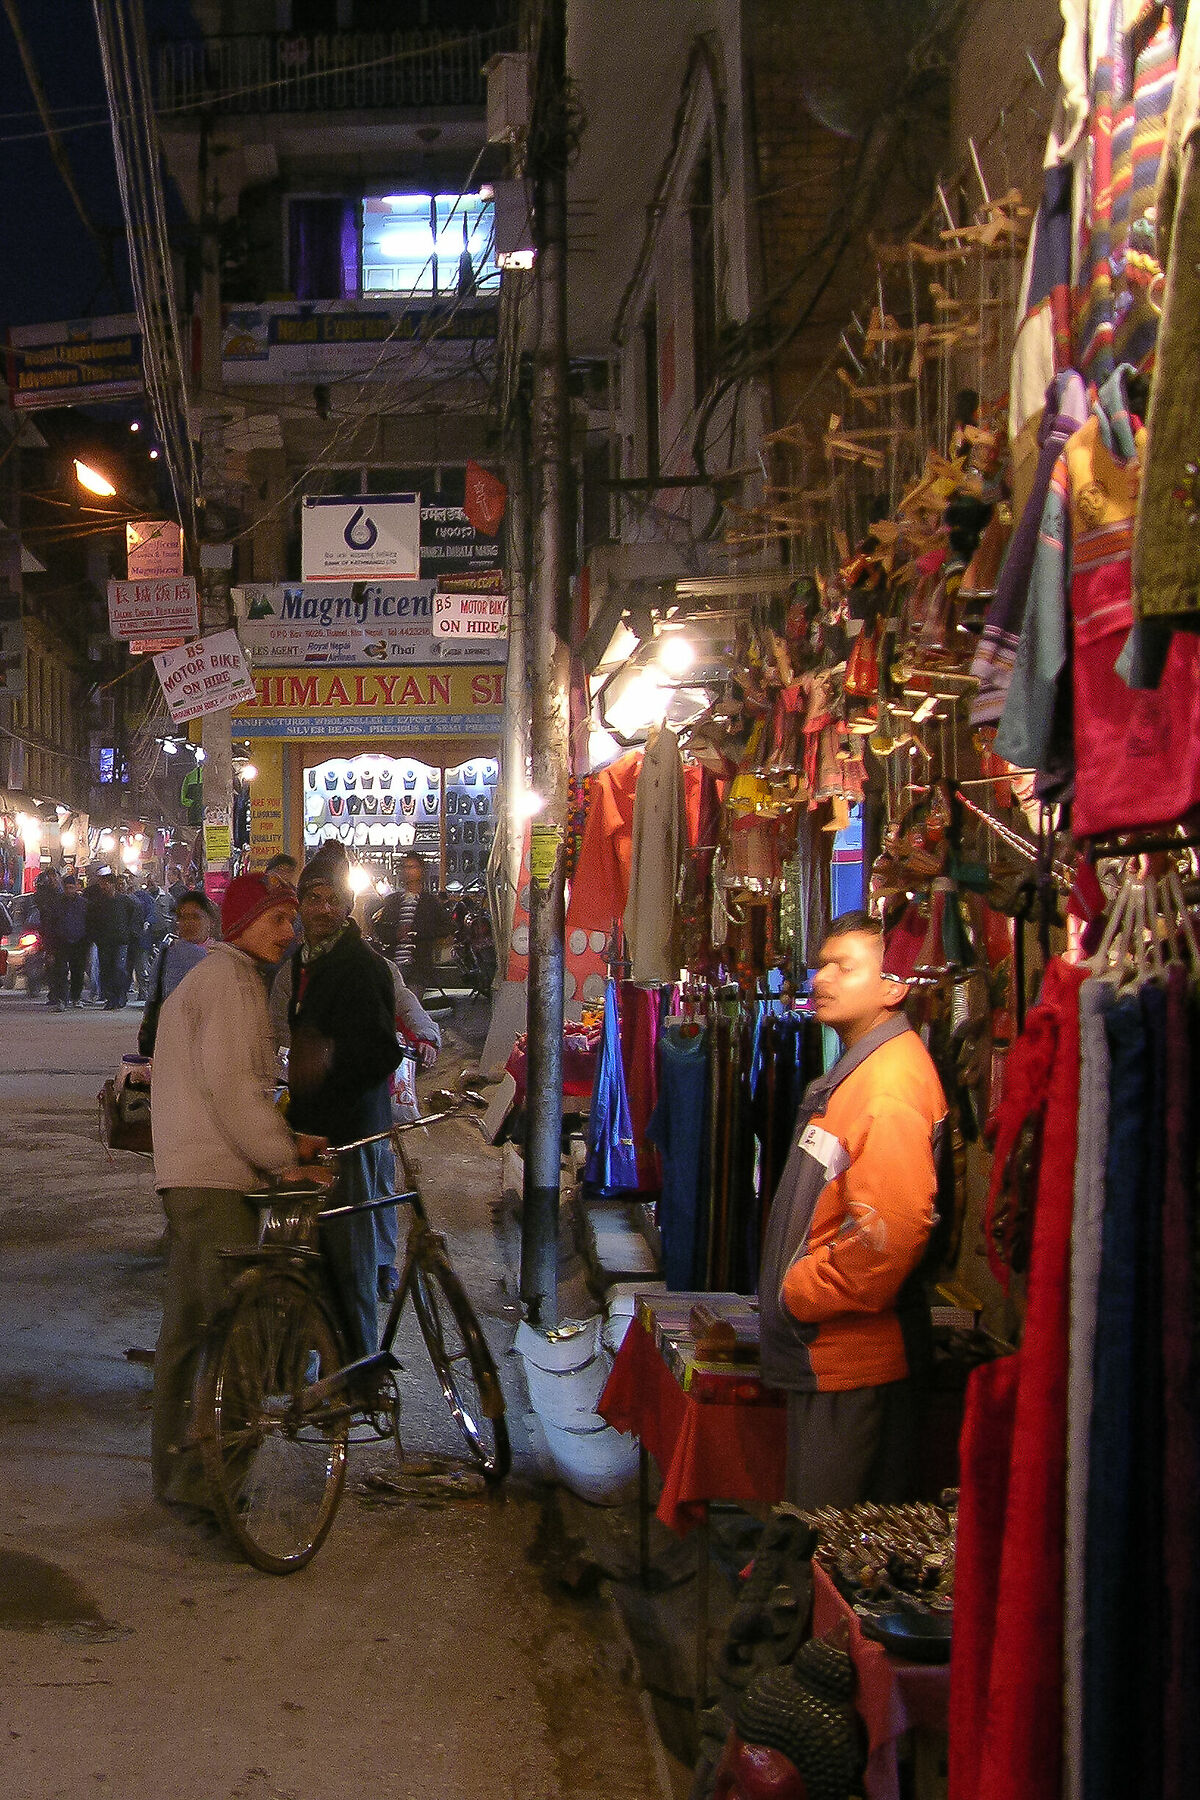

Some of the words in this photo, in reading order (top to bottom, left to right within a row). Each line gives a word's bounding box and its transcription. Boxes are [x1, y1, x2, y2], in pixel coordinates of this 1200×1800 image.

[440, 620, 460, 633] ON
[466, 620, 498, 633] HIRE
[391, 644, 416, 655] Thai
[164, 658, 205, 693] MOTOR
[210, 653, 240, 669] BIKE
[182, 680, 202, 695] ON
[245, 674, 452, 708] HIMALYAN
[286, 726, 325, 735] SILVER
[369, 724, 419, 733] PRECIOUS
